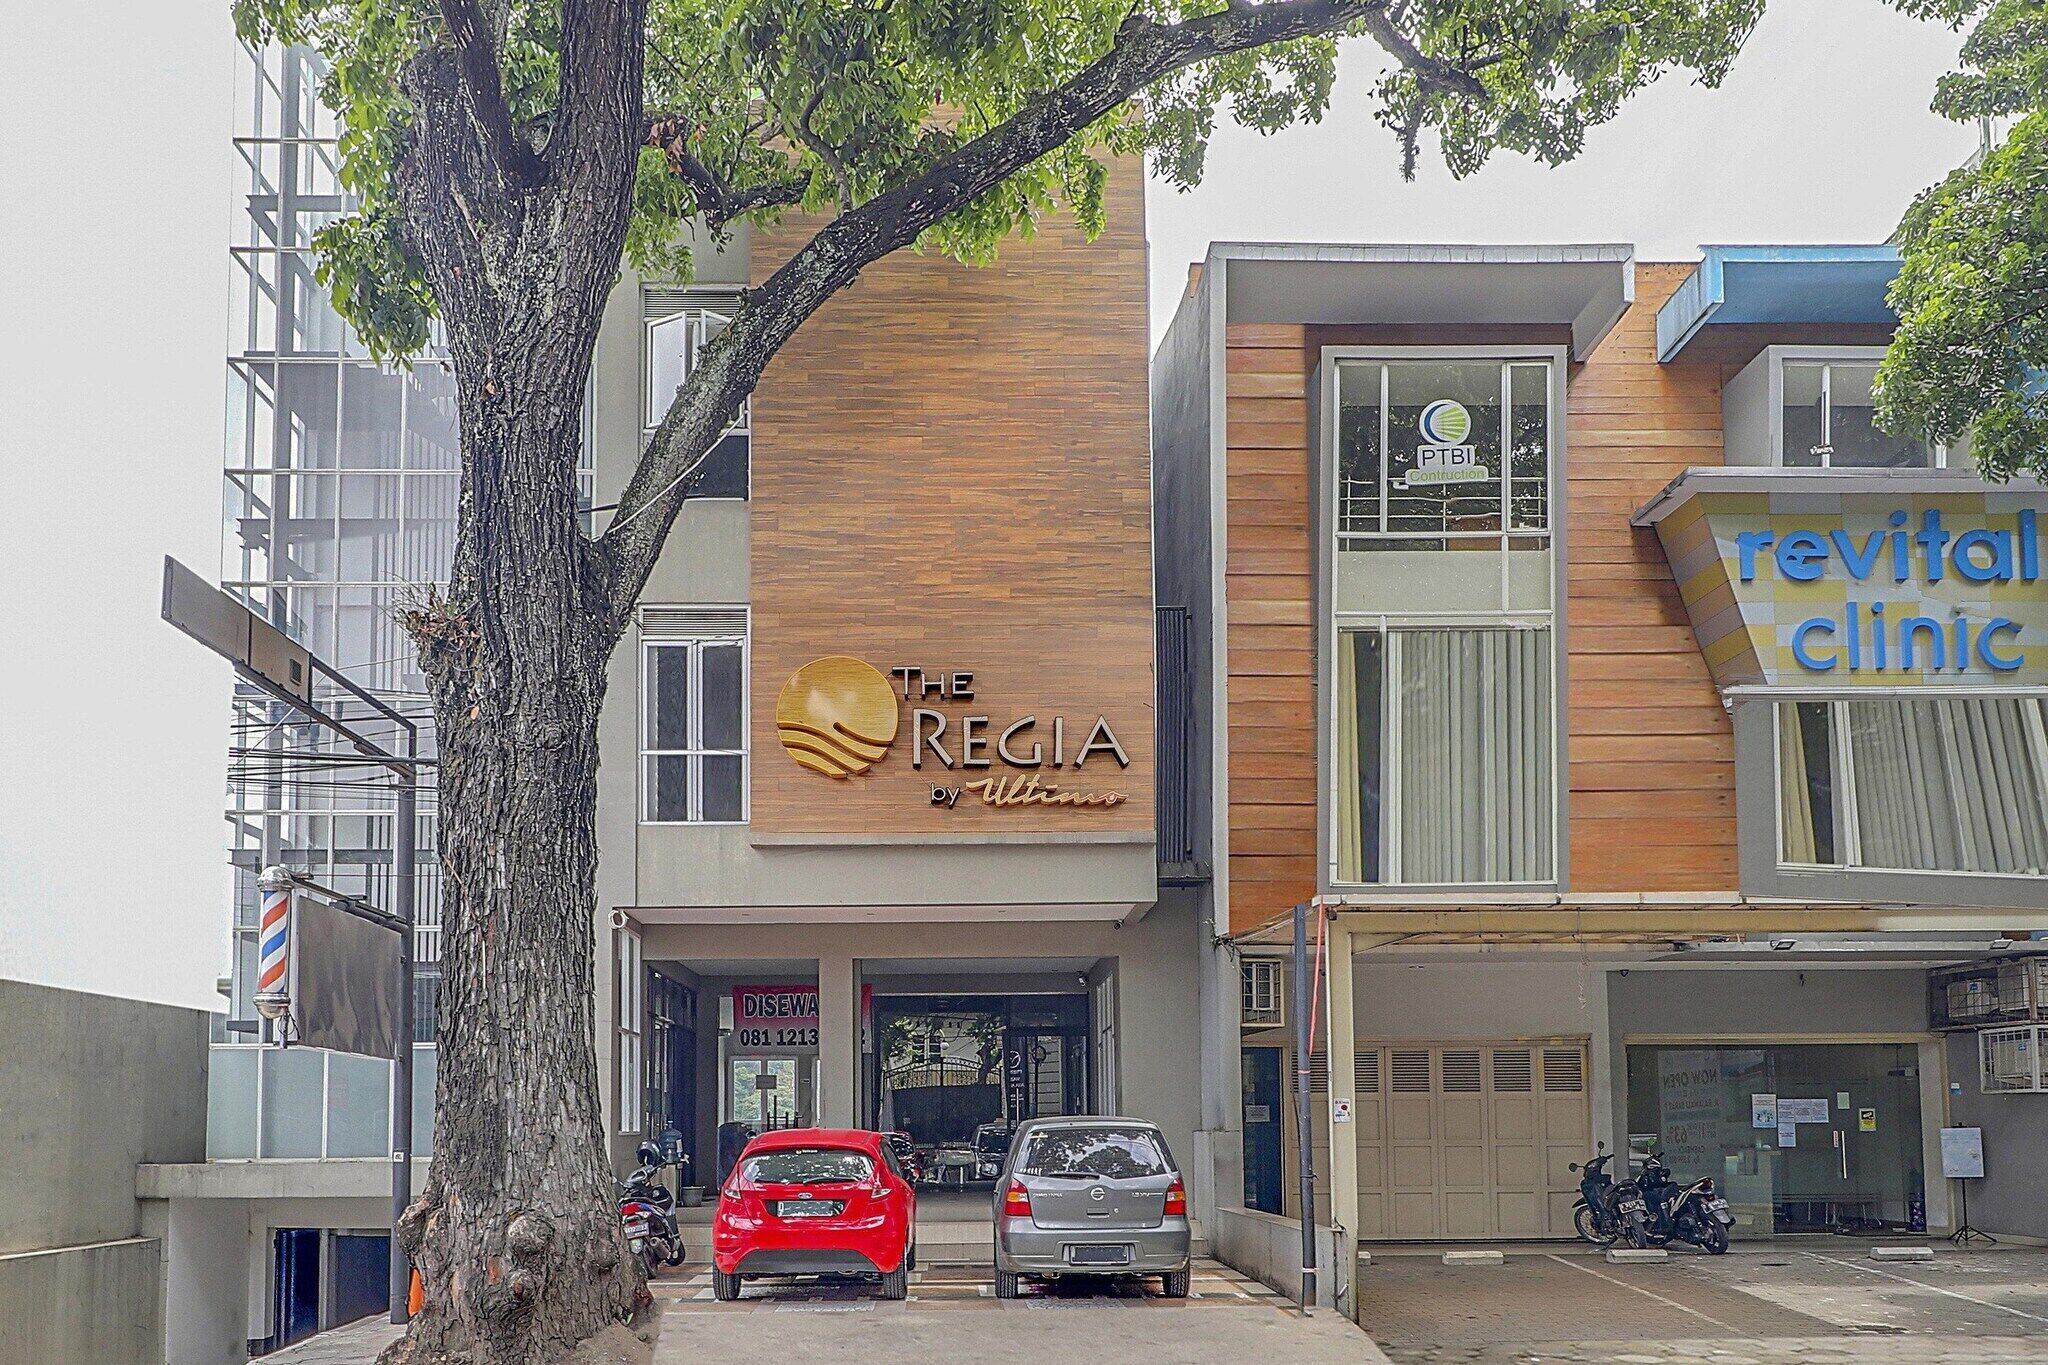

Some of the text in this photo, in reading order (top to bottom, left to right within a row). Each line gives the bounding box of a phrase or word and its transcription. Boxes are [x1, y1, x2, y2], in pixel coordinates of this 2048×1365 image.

[1422, 448, 1471, 466] PTBI
[1410, 470, 1485, 482] Contruction
[1735, 508, 2039, 583] revital
[1792, 600, 2025, 672] clinic
[892, 666, 975, 701] THE
[912, 708, 1131, 770] REGIA
[931, 774, 1130, 809] by Ultimo
[740, 1028, 772, 1046] 081
